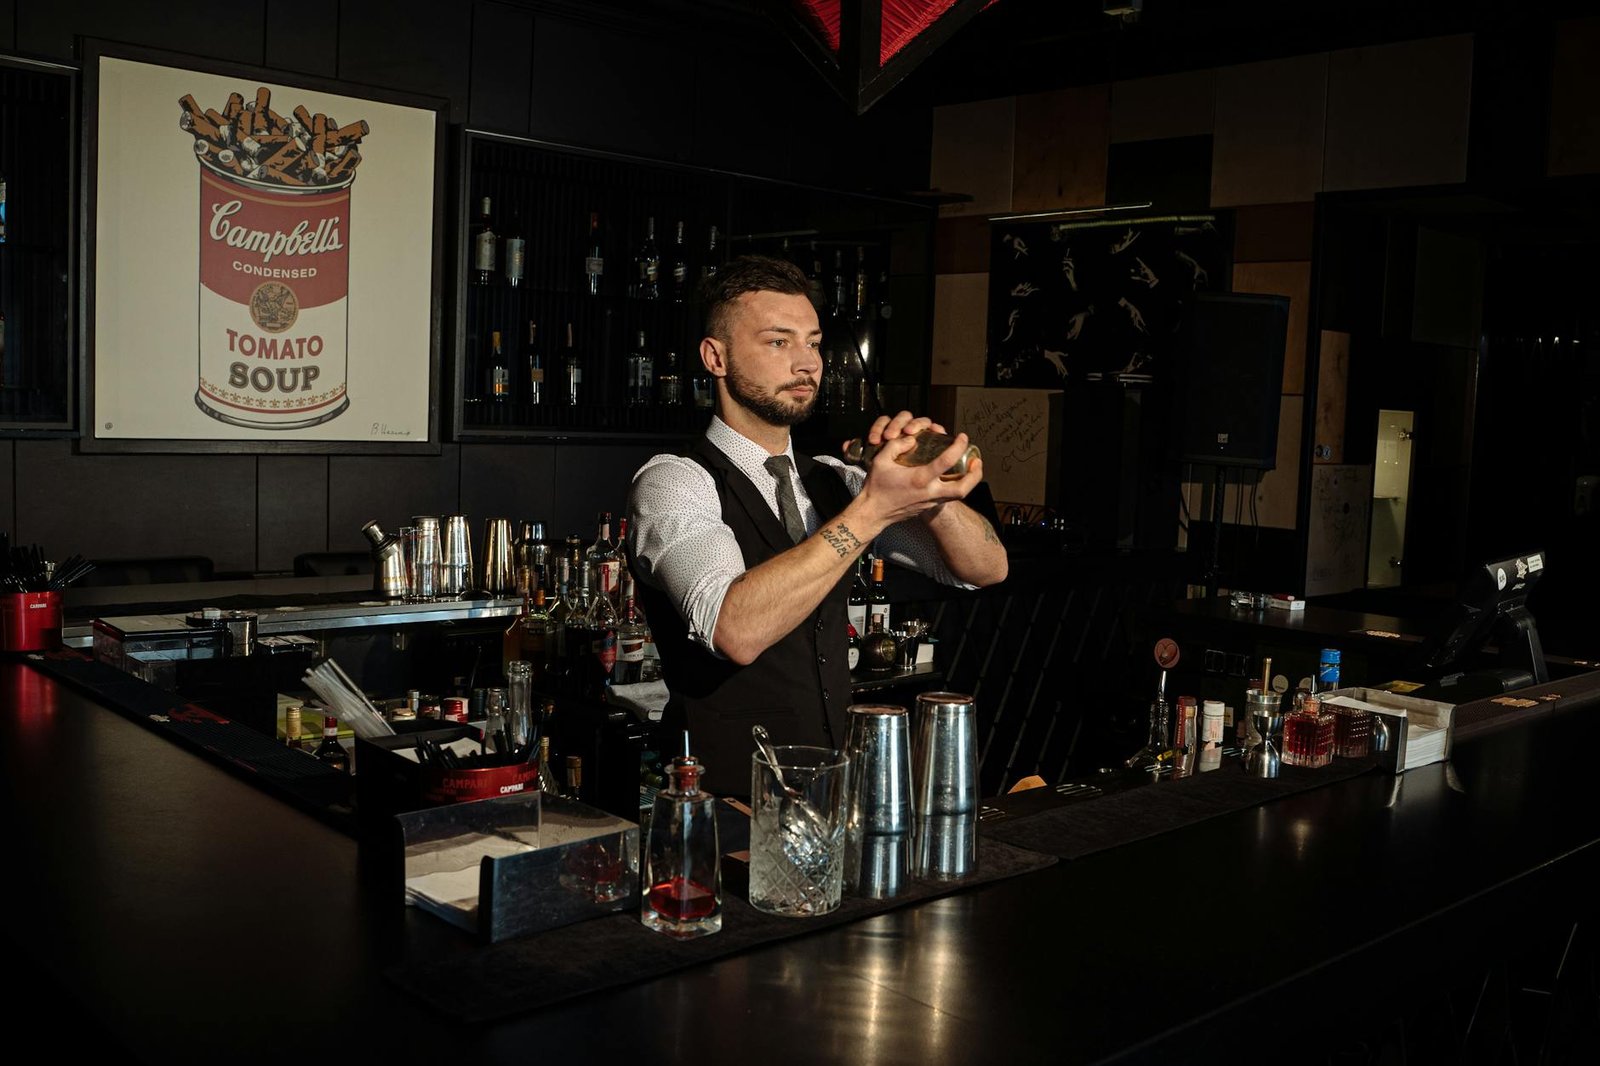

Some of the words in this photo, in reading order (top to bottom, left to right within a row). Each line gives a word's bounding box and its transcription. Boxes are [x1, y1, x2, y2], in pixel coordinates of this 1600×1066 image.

[209, 200, 344, 263] Campbell's
[232, 260, 318, 280] CONDENSED
[226, 328, 324, 360] TOMATO
[228, 362, 321, 393] SOUP
